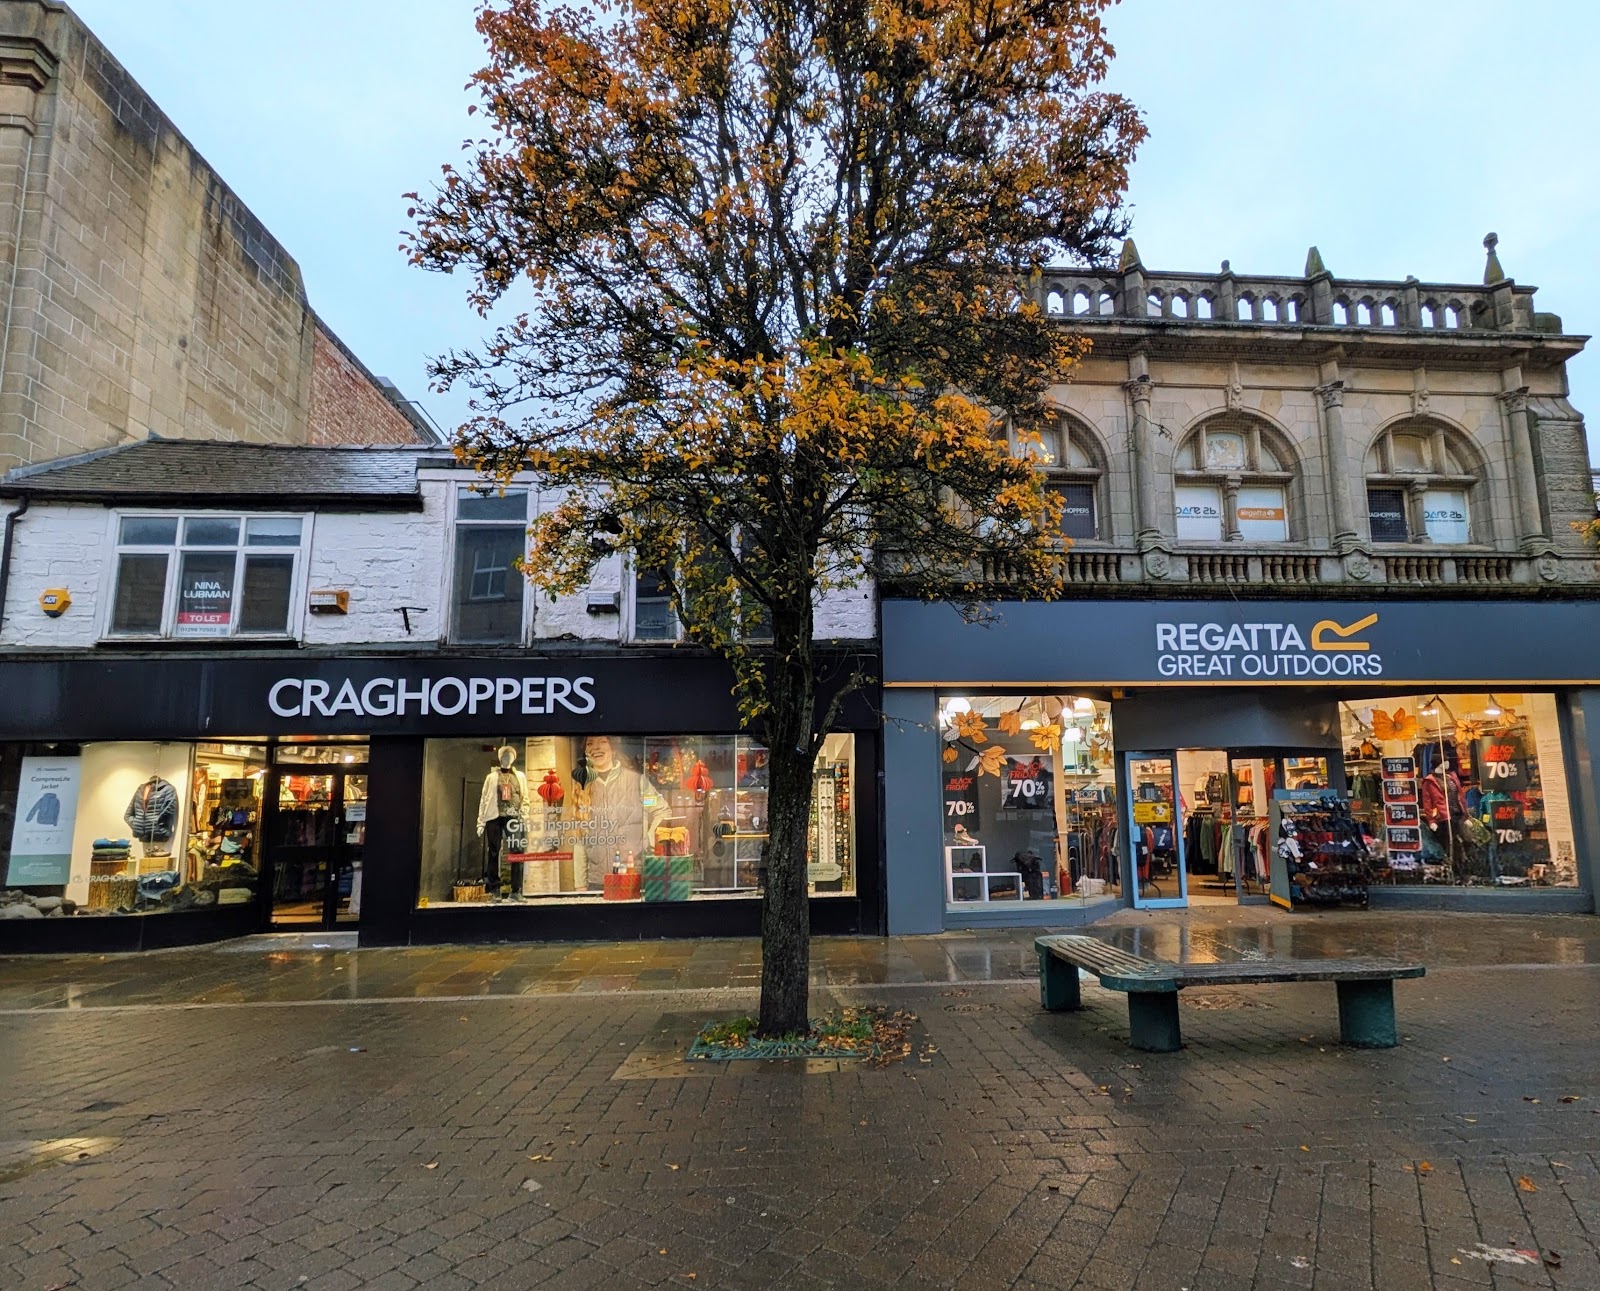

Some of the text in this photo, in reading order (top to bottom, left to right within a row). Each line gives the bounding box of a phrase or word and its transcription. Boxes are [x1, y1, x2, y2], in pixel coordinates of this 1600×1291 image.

[1240, 509, 1266, 517] Regatta
[195, 582, 221, 590] NINA
[184, 590, 230, 599] LUBMAN
[44, 595, 58, 604] ADT
[204, 615, 222, 623] LET
[1156, 623, 1306, 651] REGATTA
[1157, 654, 1382, 676] GREAT OUTDOORS
[268, 677, 596, 717] CRAGHOPPERS
[1488, 745, 1515, 754] BLACK
[1484, 753, 1511, 762] FRIDAY
[1016, 761, 1045, 770] BLACK
[1486, 761, 1518, 779] 70%
[1010, 769, 1040, 779] FRIDAY
[950, 777, 973, 785] BLACK
[1010, 779, 1046, 798] 70%
[946, 800, 975, 816] 70%
[545, 816, 597, 832] inspired
[601, 815, 618, 833] by
[506, 830, 626, 851] the great outdoors
